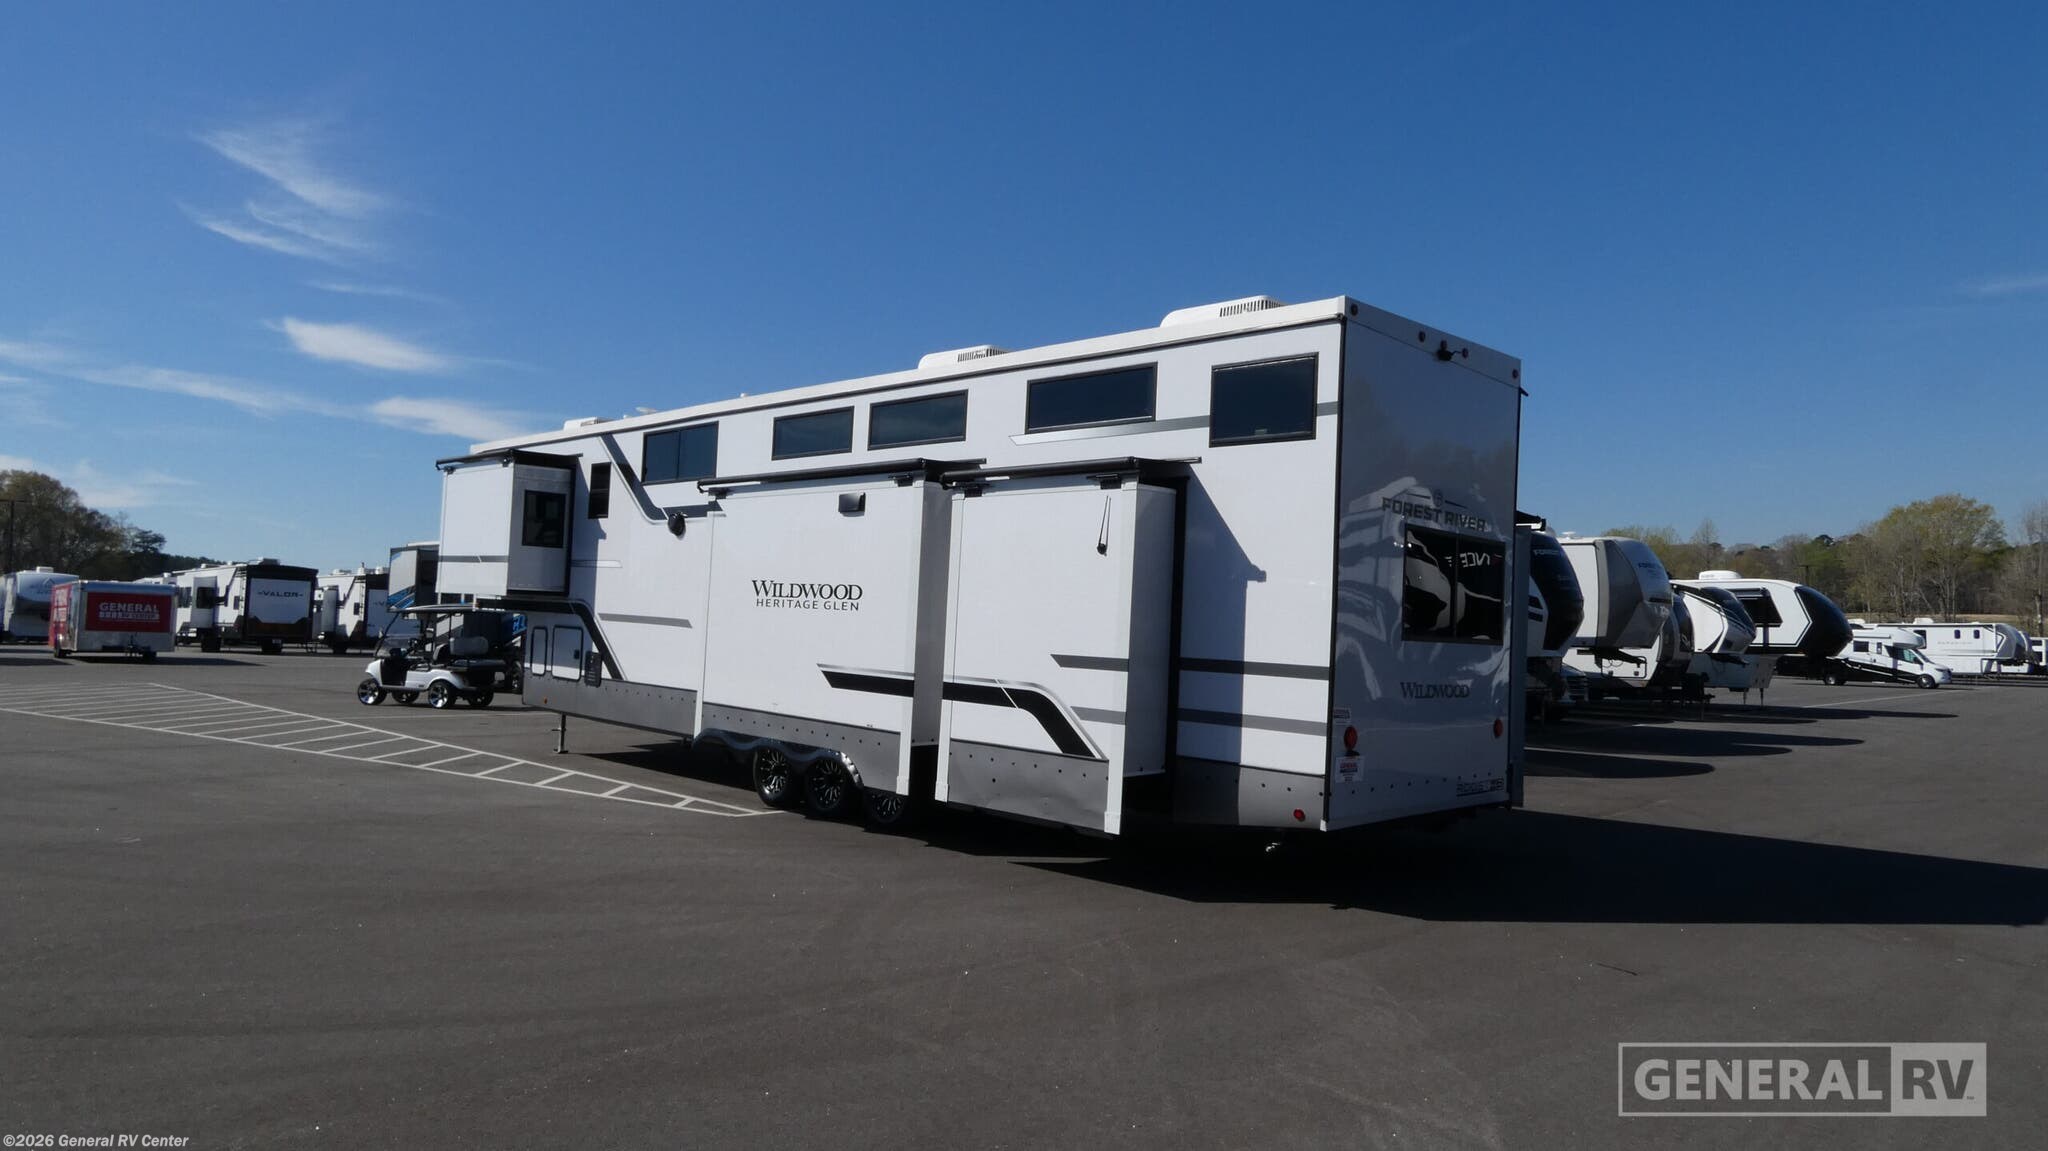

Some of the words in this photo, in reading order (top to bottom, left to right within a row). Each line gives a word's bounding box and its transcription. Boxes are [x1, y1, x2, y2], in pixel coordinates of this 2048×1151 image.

[1382, 497, 1441, 523] FOREST
[263, 589, 298, 598] VALOR
[752, 580, 863, 600] WILDWOOD
[99, 602, 159, 613] GENERAL
[756, 599, 819, 610] HERITAGE
[823, 600, 859, 611] GLEN
[1400, 682, 1470, 699] WILDWOOD
